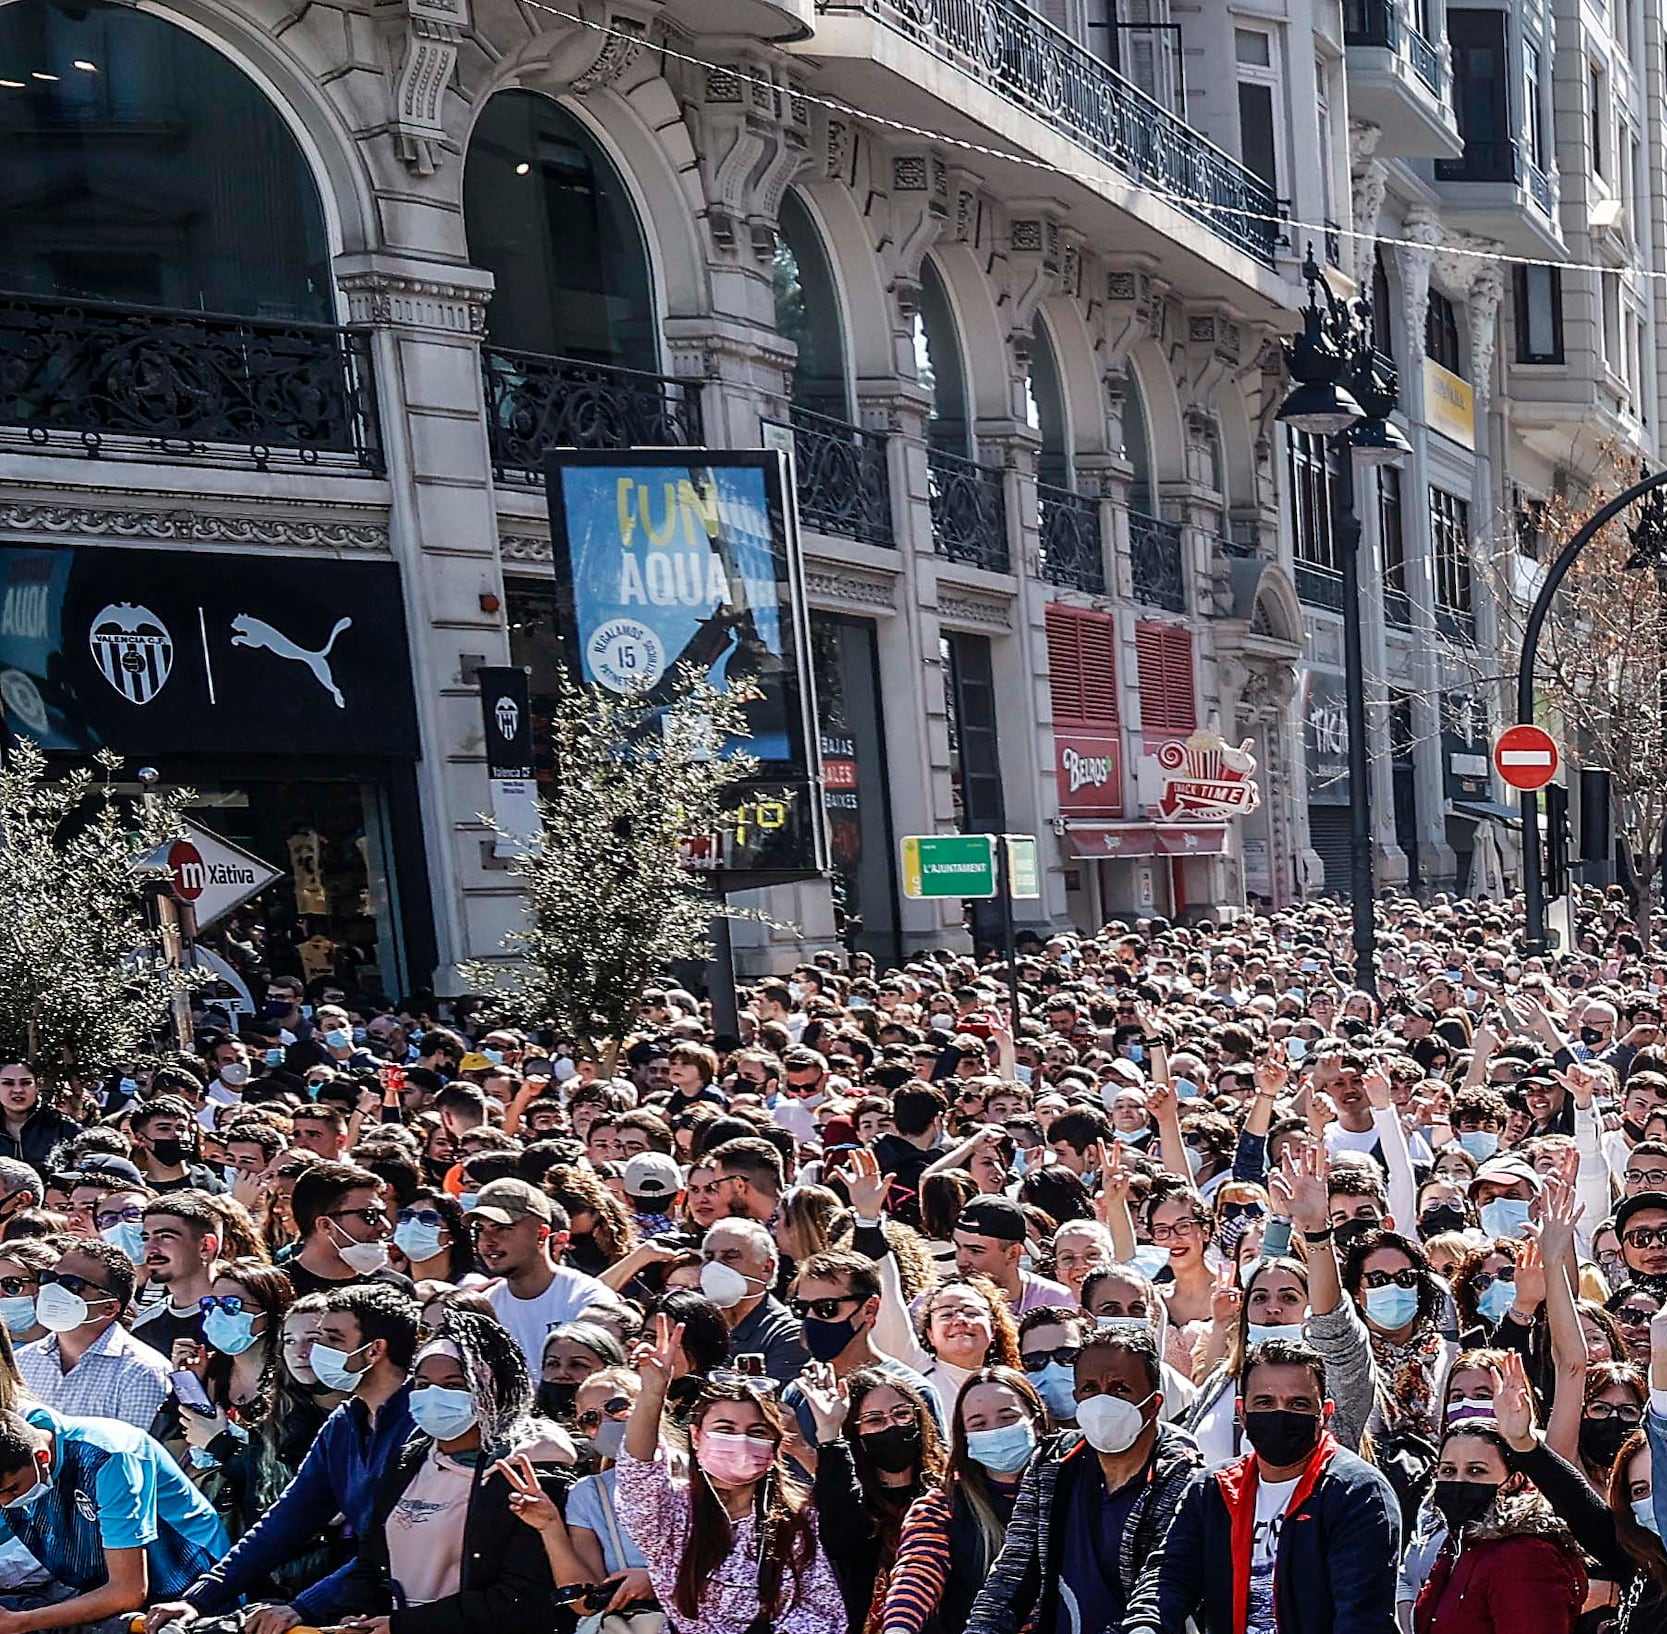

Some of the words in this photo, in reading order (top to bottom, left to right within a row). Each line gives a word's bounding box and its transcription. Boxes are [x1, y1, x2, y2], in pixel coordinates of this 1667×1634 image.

[617, 477, 721, 547] FUN
[620, 551, 734, 607] AQUA
[96, 635, 146, 645] VALENCIA
[617, 645, 636, 669] 15
[1201, 784, 1244, 804] TIME
[209, 862, 255, 885] Xàtiva
